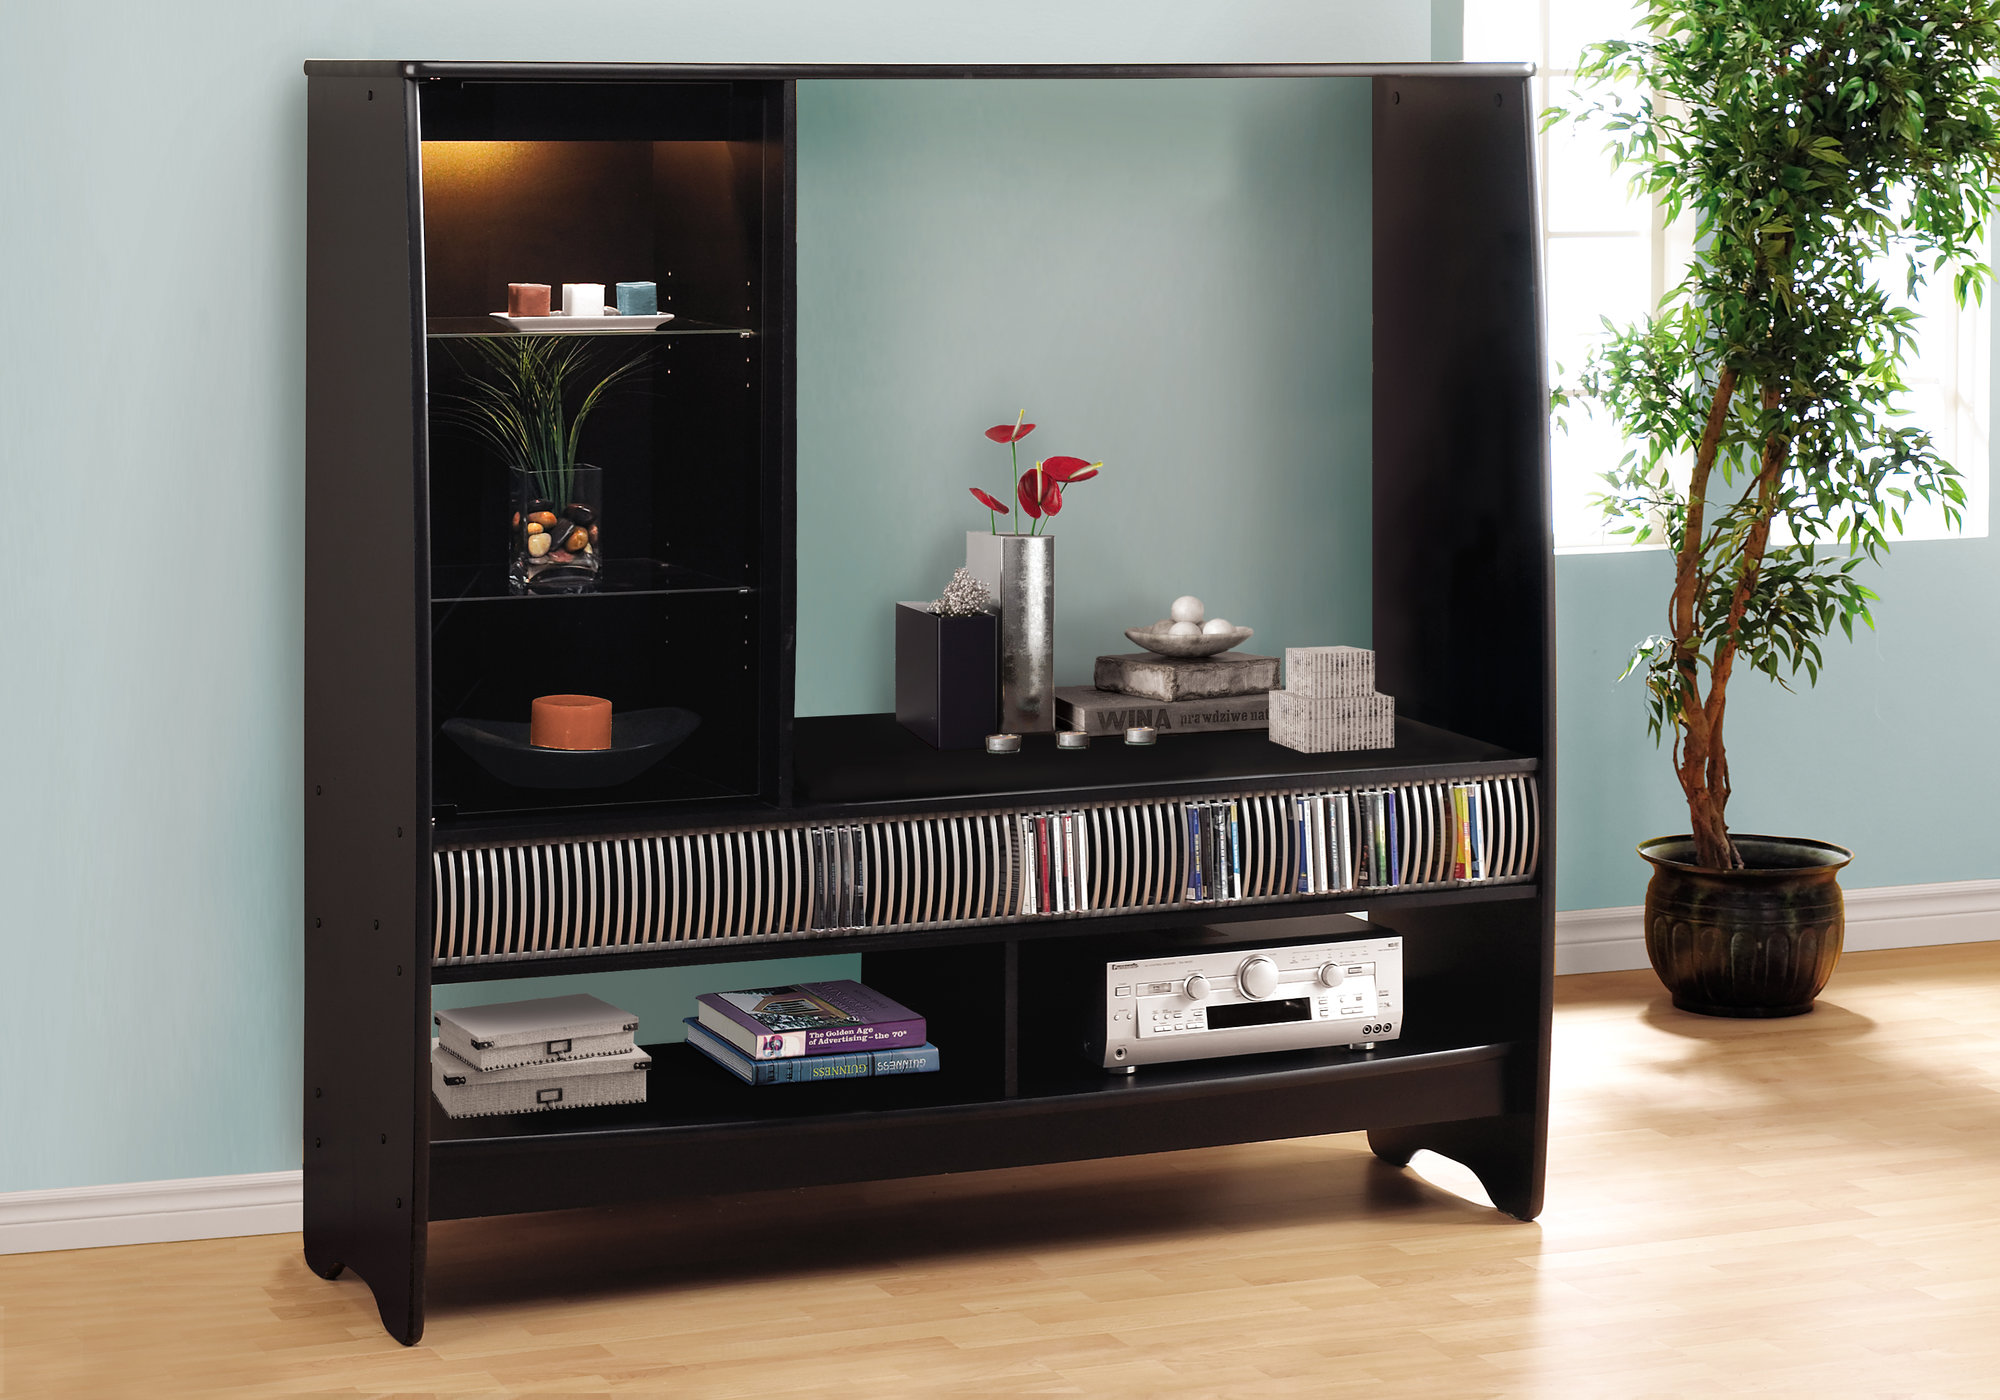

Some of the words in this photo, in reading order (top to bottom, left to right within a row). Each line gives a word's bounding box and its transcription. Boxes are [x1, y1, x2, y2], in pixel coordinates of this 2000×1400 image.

[1097, 708, 1172, 730] WINA
[1180, 709, 1248, 726] prawdziwe
[825, 1029, 854, 1037] Golden
[856, 1027, 874, 1035] Age
[813, 1063, 867, 1077] GUINNESS
[877, 1058, 927, 1072] GUINNESS
